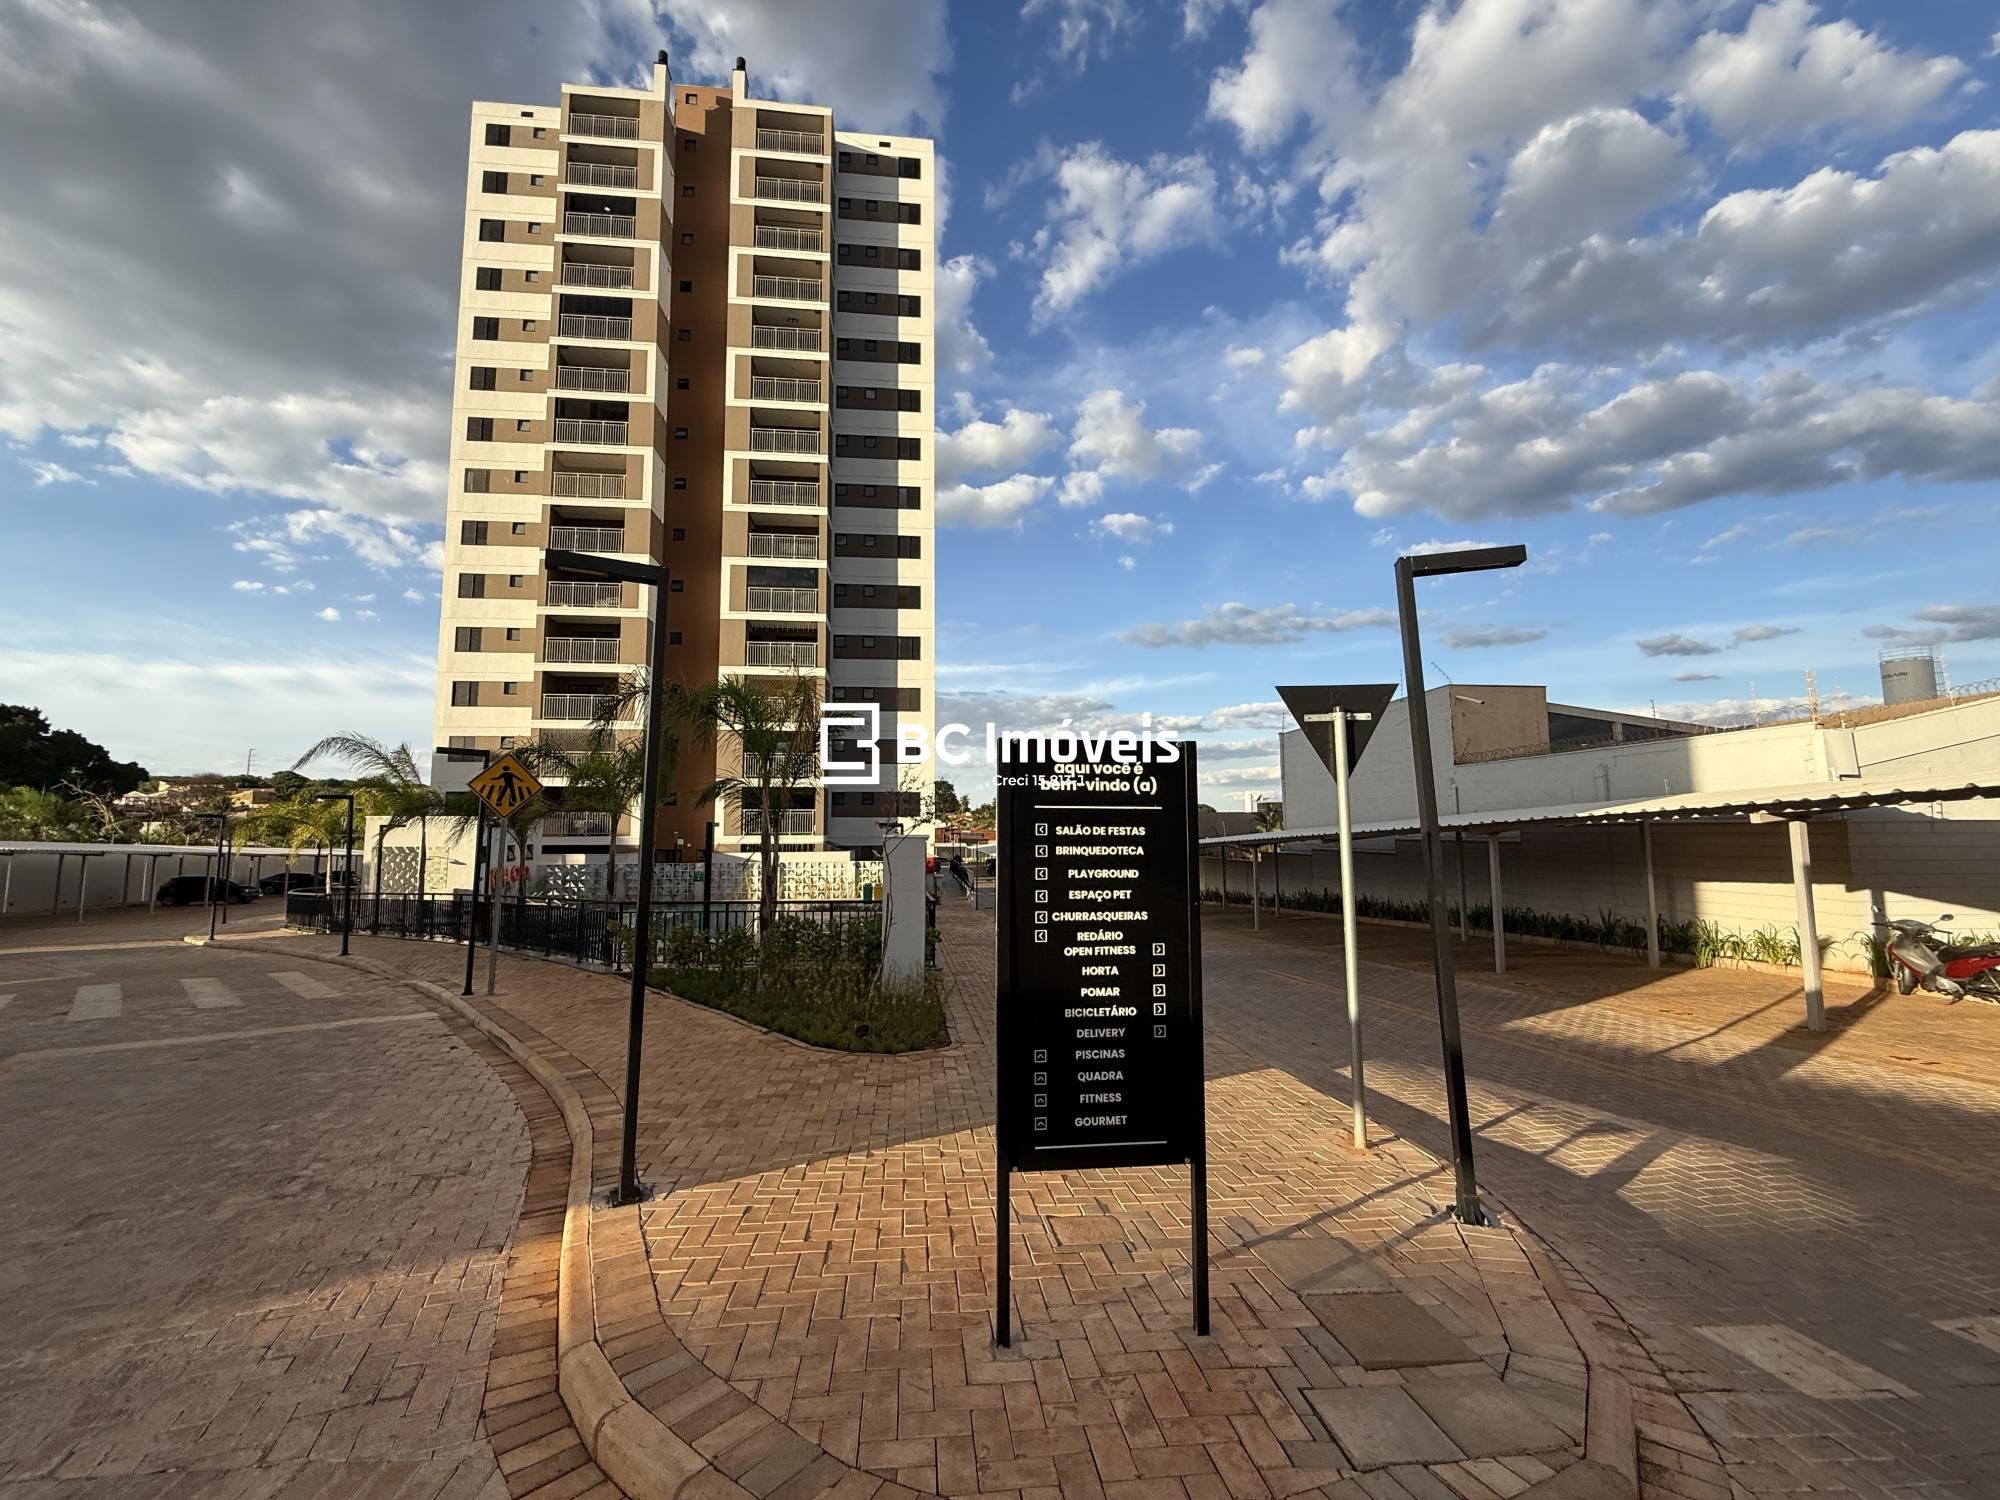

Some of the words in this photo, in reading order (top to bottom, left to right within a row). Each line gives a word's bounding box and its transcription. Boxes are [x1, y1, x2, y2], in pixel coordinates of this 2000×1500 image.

[1092, 760, 1132, 775] você
[1133, 760, 1144, 775] é
[1039, 777, 1131, 792] bem-vindo
[1133, 776, 1158, 795] (a)
[1055, 824, 1092, 836] SALÃO
[1092, 826, 1107, 836] DE
[1107, 826, 1146, 836] FESTAS
[1055, 846, 1145, 857] BRINQUEDOTECA
[1067, 868, 1140, 879] PLAYGROUND
[1068, 890, 1112, 902] ESPAÇO
[1113, 890, 1133, 900] PET
[1051, 910, 1149, 922] CHURRASQUEIRAS
[1076, 928, 1124, 942] REDÁRIO
[1063, 946, 1093, 957] OPEN
[1094, 945, 1137, 956] FITNESS
[1081, 966, 1120, 976] HORTA
[1080, 987, 1121, 998] POMAR
[1064, 1005, 1138, 1018] BICICLETÁRIO
[1076, 1027, 1126, 1039] DELIVERY
[1075, 1048, 1126, 1060] PISCINAS
[1077, 1070, 1124, 1083] QUADRA
[1079, 1092, 1122, 1104] FITNESS
[1074, 1115, 1128, 1127] GOURMET
